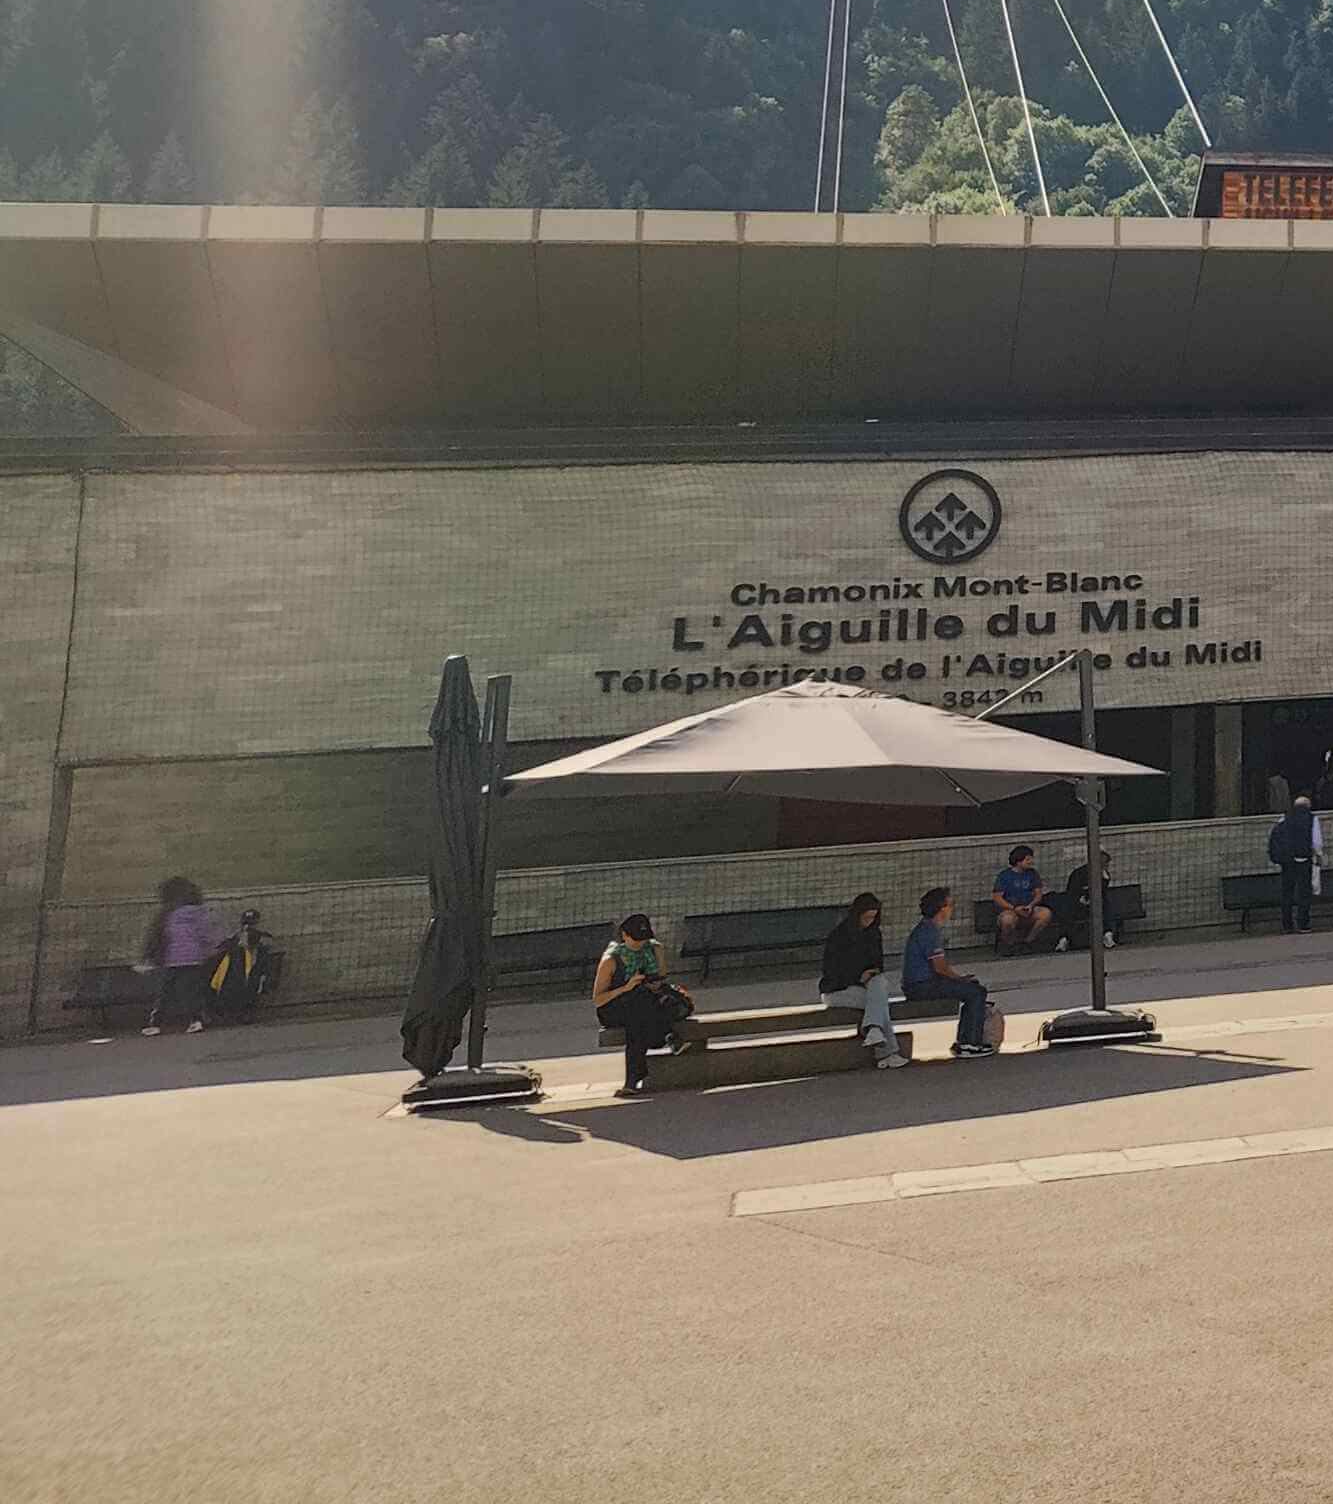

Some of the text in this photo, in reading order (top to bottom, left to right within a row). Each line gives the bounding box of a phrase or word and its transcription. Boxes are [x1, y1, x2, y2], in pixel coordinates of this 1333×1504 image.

[730, 572, 1144, 607] Chamonix Mont-Blanc
[672, 597, 1200, 654] L'Aiguille du Midi
[881, 658, 926, 682] de
[942, 648, 1112, 679] l'Aiguile
[1126, 647, 1170, 669] du
[1186, 640, 1262, 666] Midi
[1021, 689, 1043, 704] m
